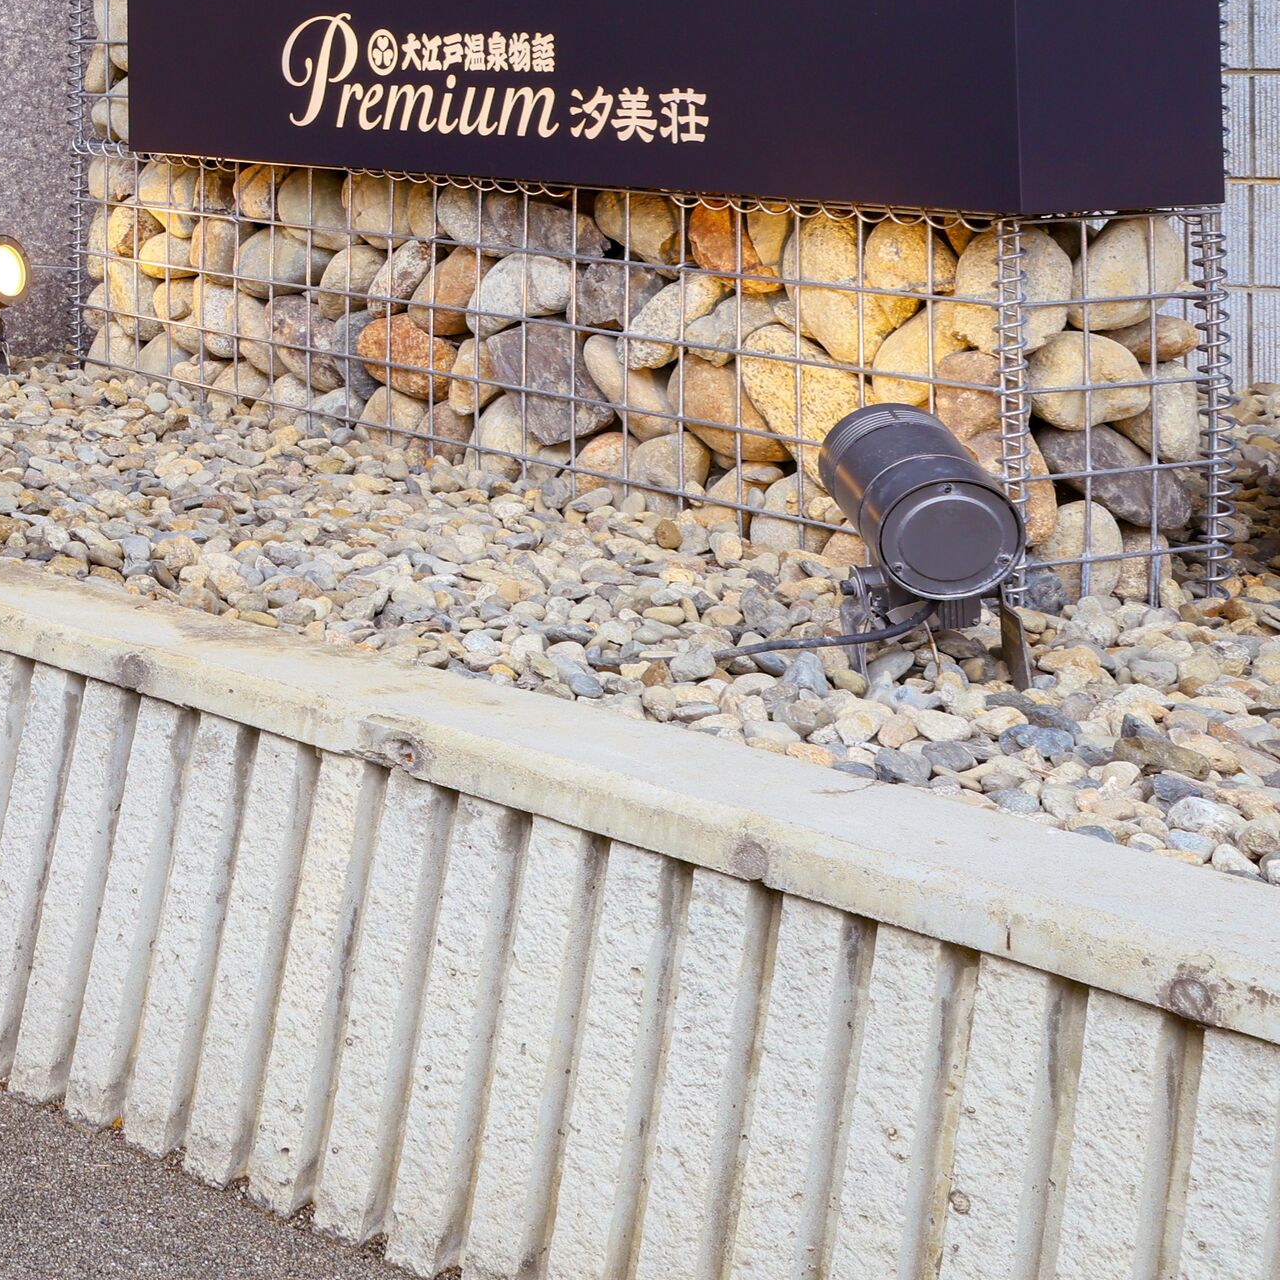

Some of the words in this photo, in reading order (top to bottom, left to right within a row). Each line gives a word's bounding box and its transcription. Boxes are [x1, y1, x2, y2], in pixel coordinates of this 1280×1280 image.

[281, 12, 560, 139] Premium
[569, 85, 710, 145] 汐美荘
[401, 30, 556, 73] 大江戸温泉物語
